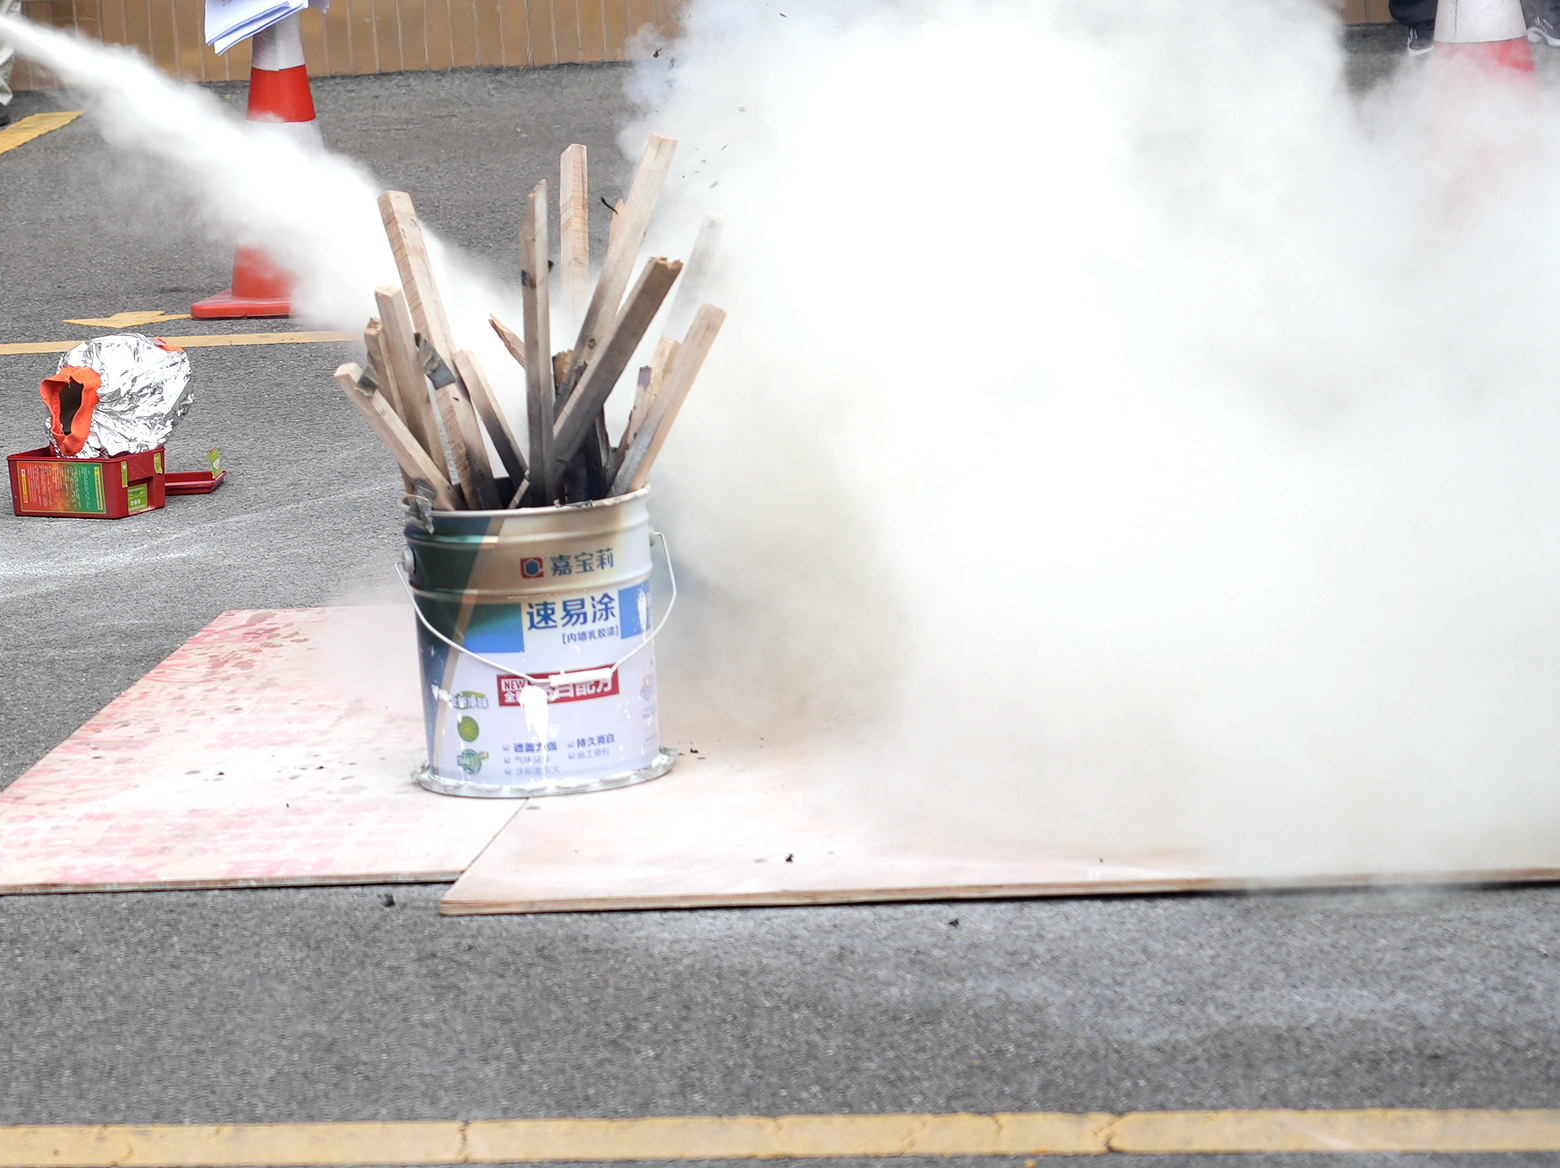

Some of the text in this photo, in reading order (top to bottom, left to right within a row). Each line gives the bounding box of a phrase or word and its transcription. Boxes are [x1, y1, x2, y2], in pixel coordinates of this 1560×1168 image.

[549, 547, 615, 577] 嘉宝莉
[526, 592, 617, 631] 速易涂
[504, 678, 525, 690] NEW
